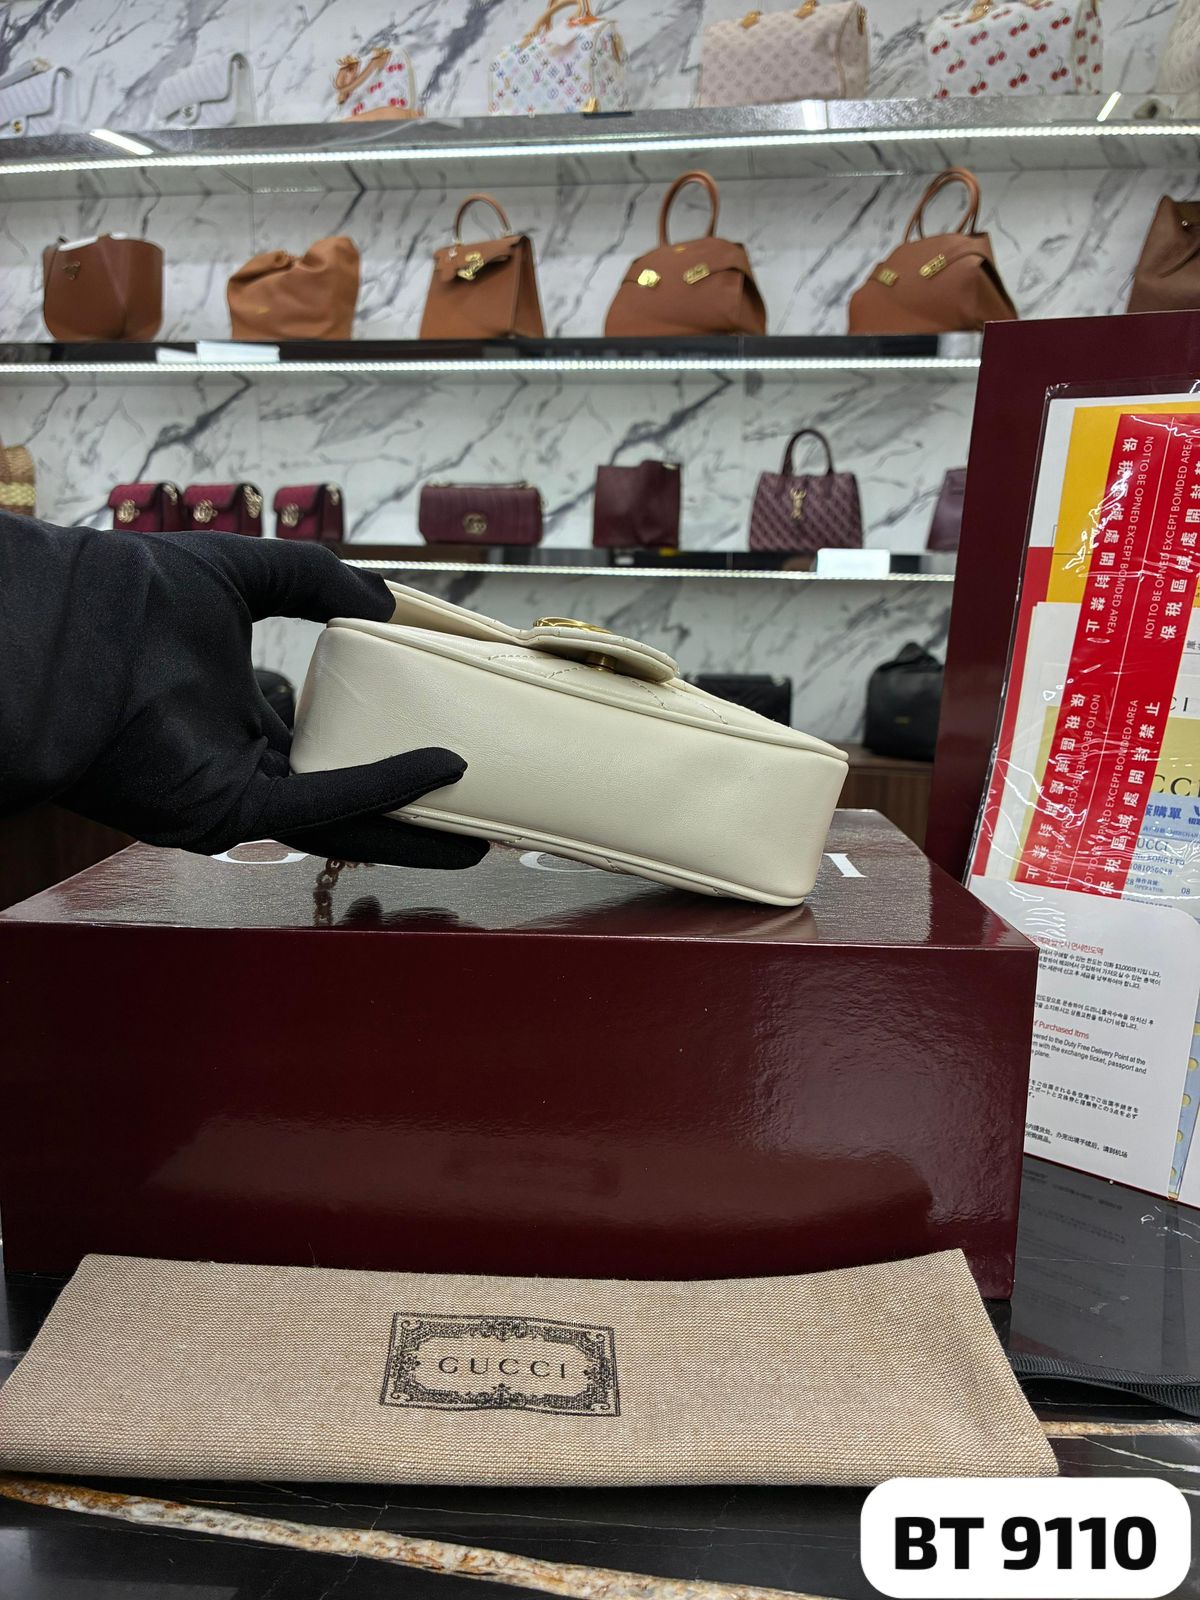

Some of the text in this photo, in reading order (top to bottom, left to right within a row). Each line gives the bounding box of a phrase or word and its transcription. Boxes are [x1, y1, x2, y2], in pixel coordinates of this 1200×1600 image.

[1106, 436, 1154, 635] NOT TO BE OPNED EXCEPT BOMDED AREA
[1143, 437, 1194, 639] NOT TO BE OPNED EXCEPT BOMDED AREA
[1089, 694, 1101, 715] NOT
[1086, 716, 1096, 729] TO
[1083, 730, 1093, 742] BE
[1105, 773, 1121, 808] EXCEPT
[1114, 727, 1132, 771] BOMDED
[1125, 699, 1138, 725] AREA
[1039, 1020, 1073, 1036] Purchased
[1039, 1042, 1050, 1050] with
[1050, 1044, 1060, 1052] the
[1060, 1047, 1089, 1061] exchange
[1107, 1060, 1135, 1071] passport
[1134, 1066, 1148, 1075] and
[1063, 1039, 1077, 1050] Duty
[1077, 1042, 1091, 1052] Free
[1090, 1046, 1113, 1059] Delivery
[1113, 1051, 1129, 1062] Point
[1136, 1057, 1147, 1066] the
[438, 1356, 567, 1379] GUCCI
